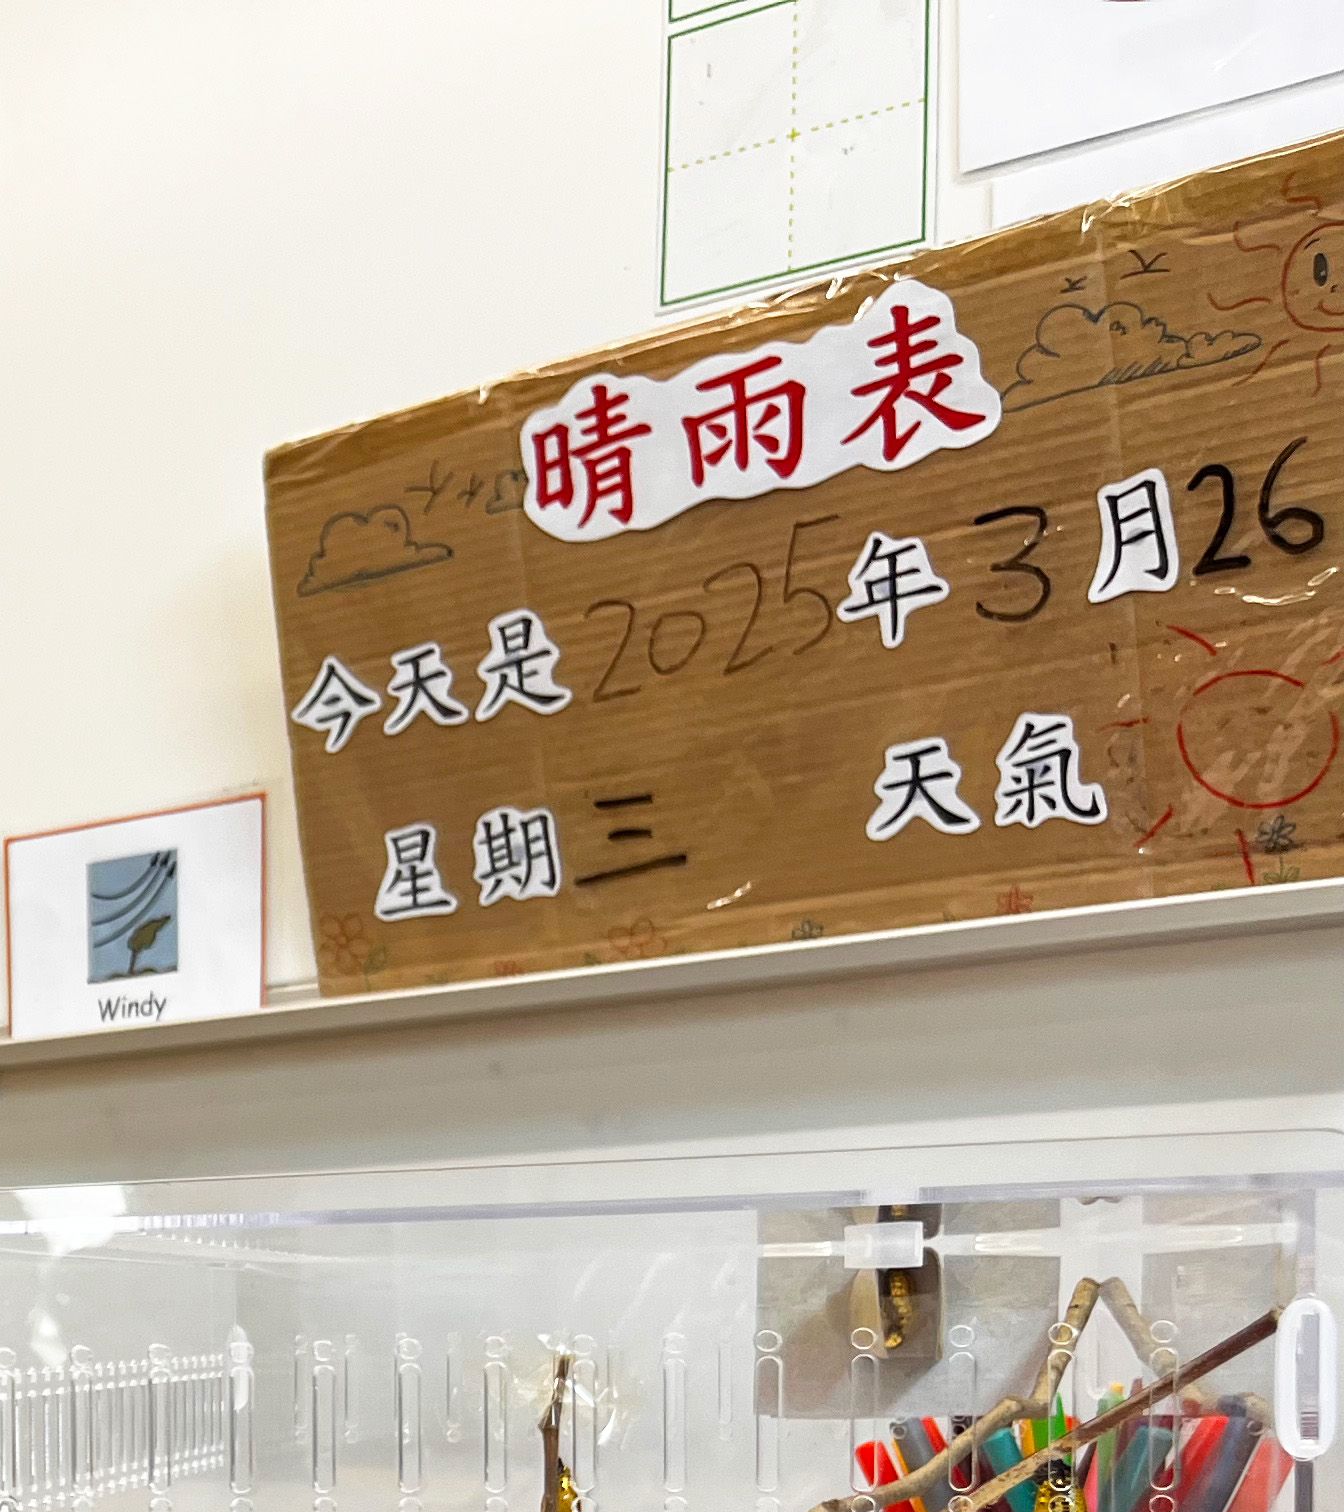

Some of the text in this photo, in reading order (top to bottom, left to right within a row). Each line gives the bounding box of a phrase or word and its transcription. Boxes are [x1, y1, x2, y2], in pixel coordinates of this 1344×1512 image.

[531, 305, 986, 529] 晴雨表
[875, 721, 1100, 831] 天氣
[380, 794, 688, 917] 星期三
[97, 990, 168, 1022] Windy
